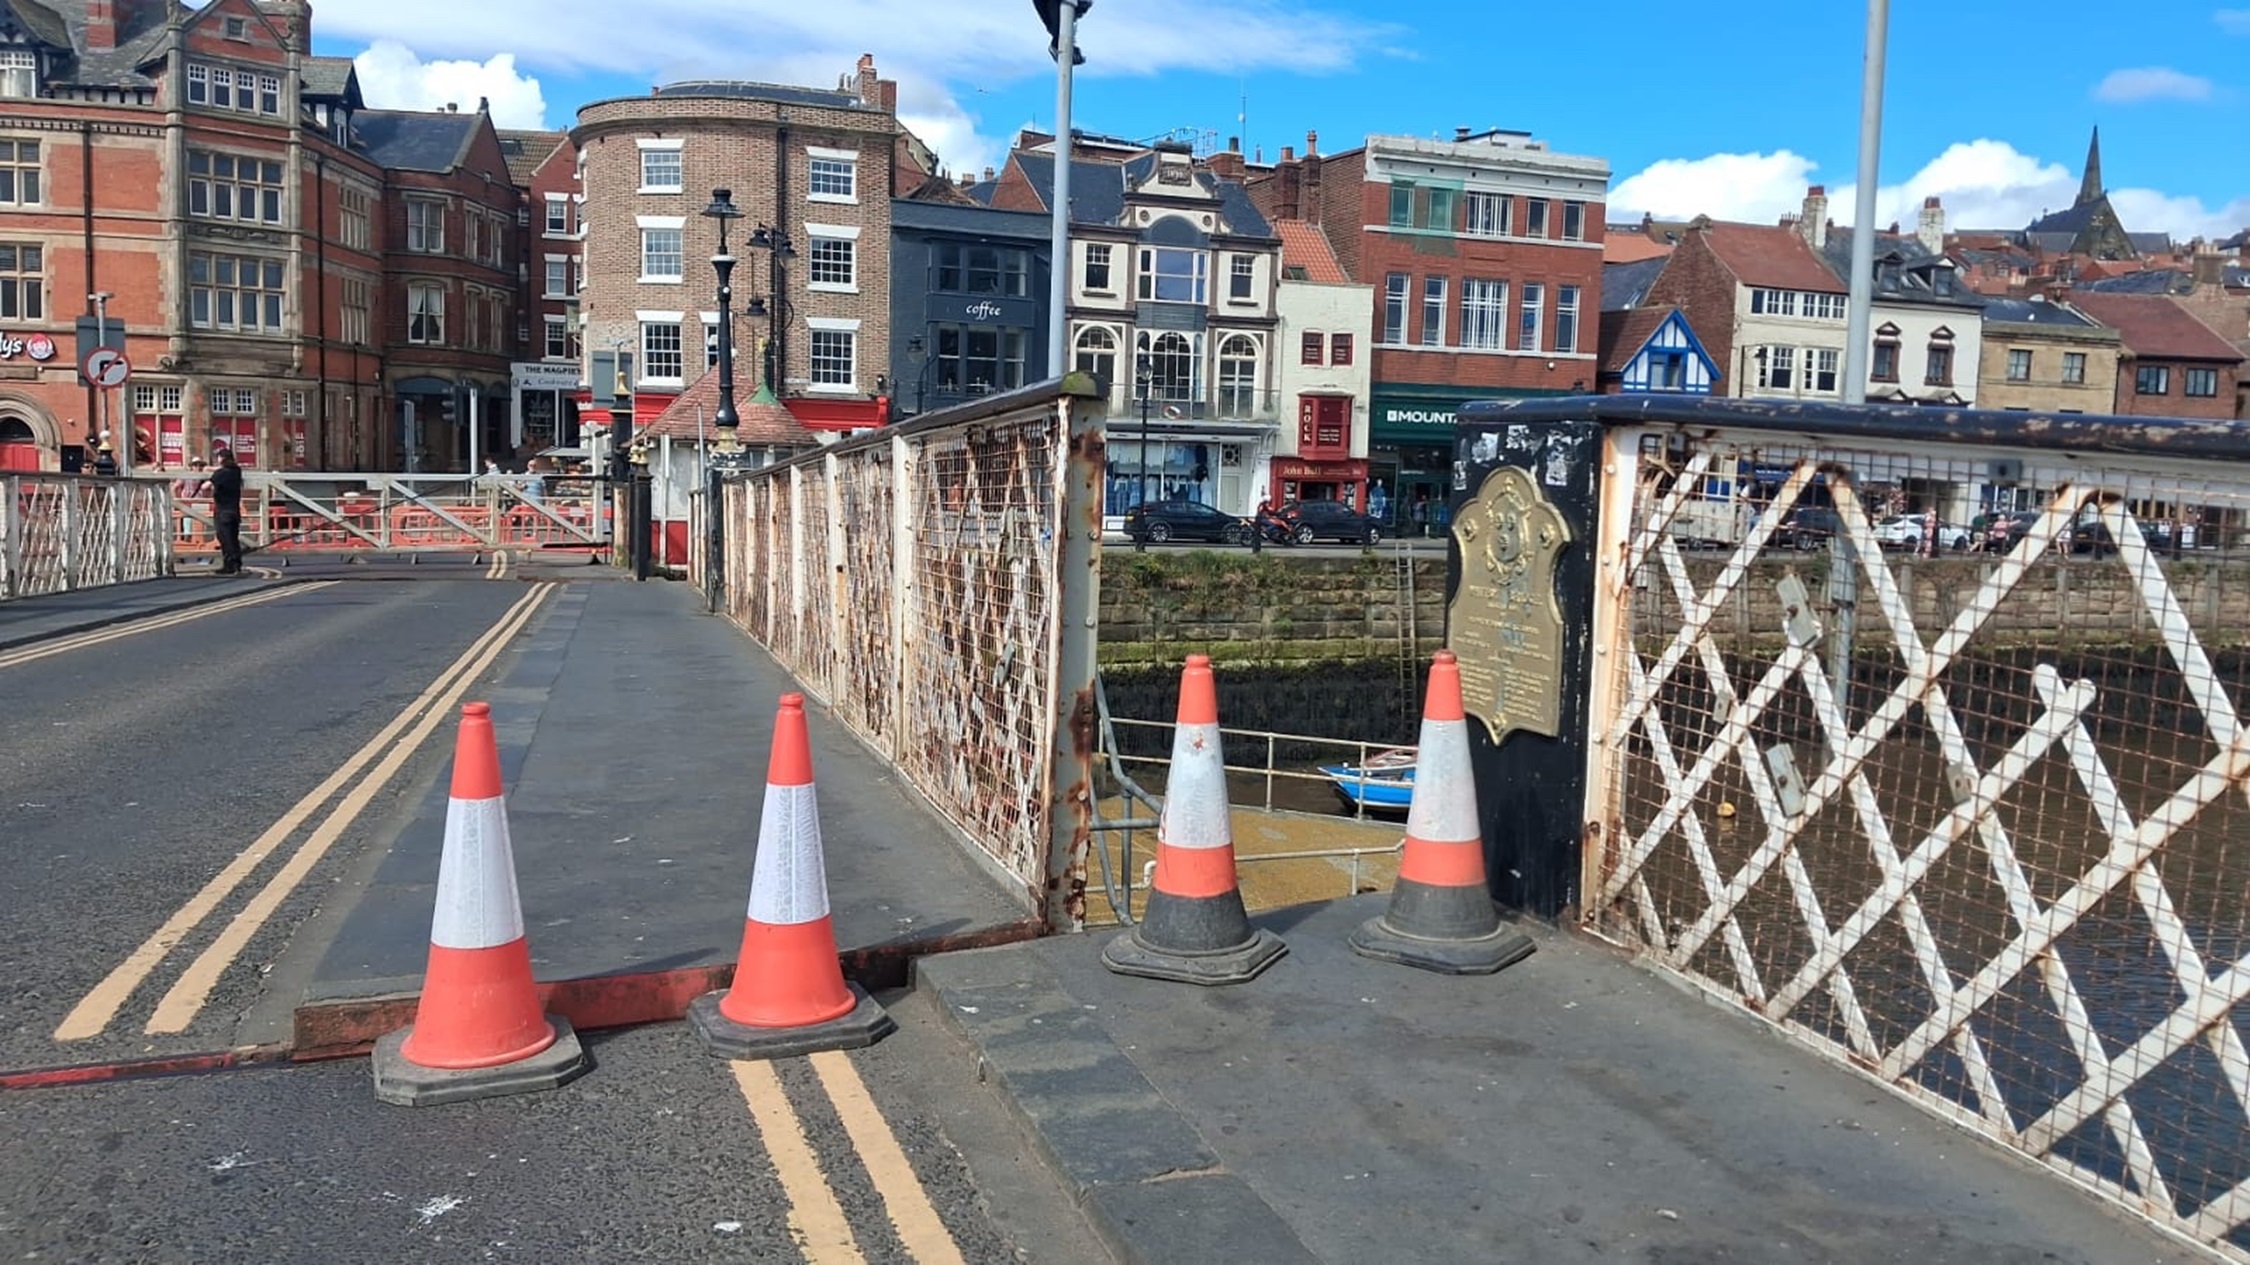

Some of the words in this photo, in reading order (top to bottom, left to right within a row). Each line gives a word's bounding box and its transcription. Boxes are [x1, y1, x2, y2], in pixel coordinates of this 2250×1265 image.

[966, 301, 1001, 320] coffee
[1398, 410, 1458, 424] MOUNT
[1283, 465, 1303, 476] John
[1304, 466, 1321, 476] Bull
